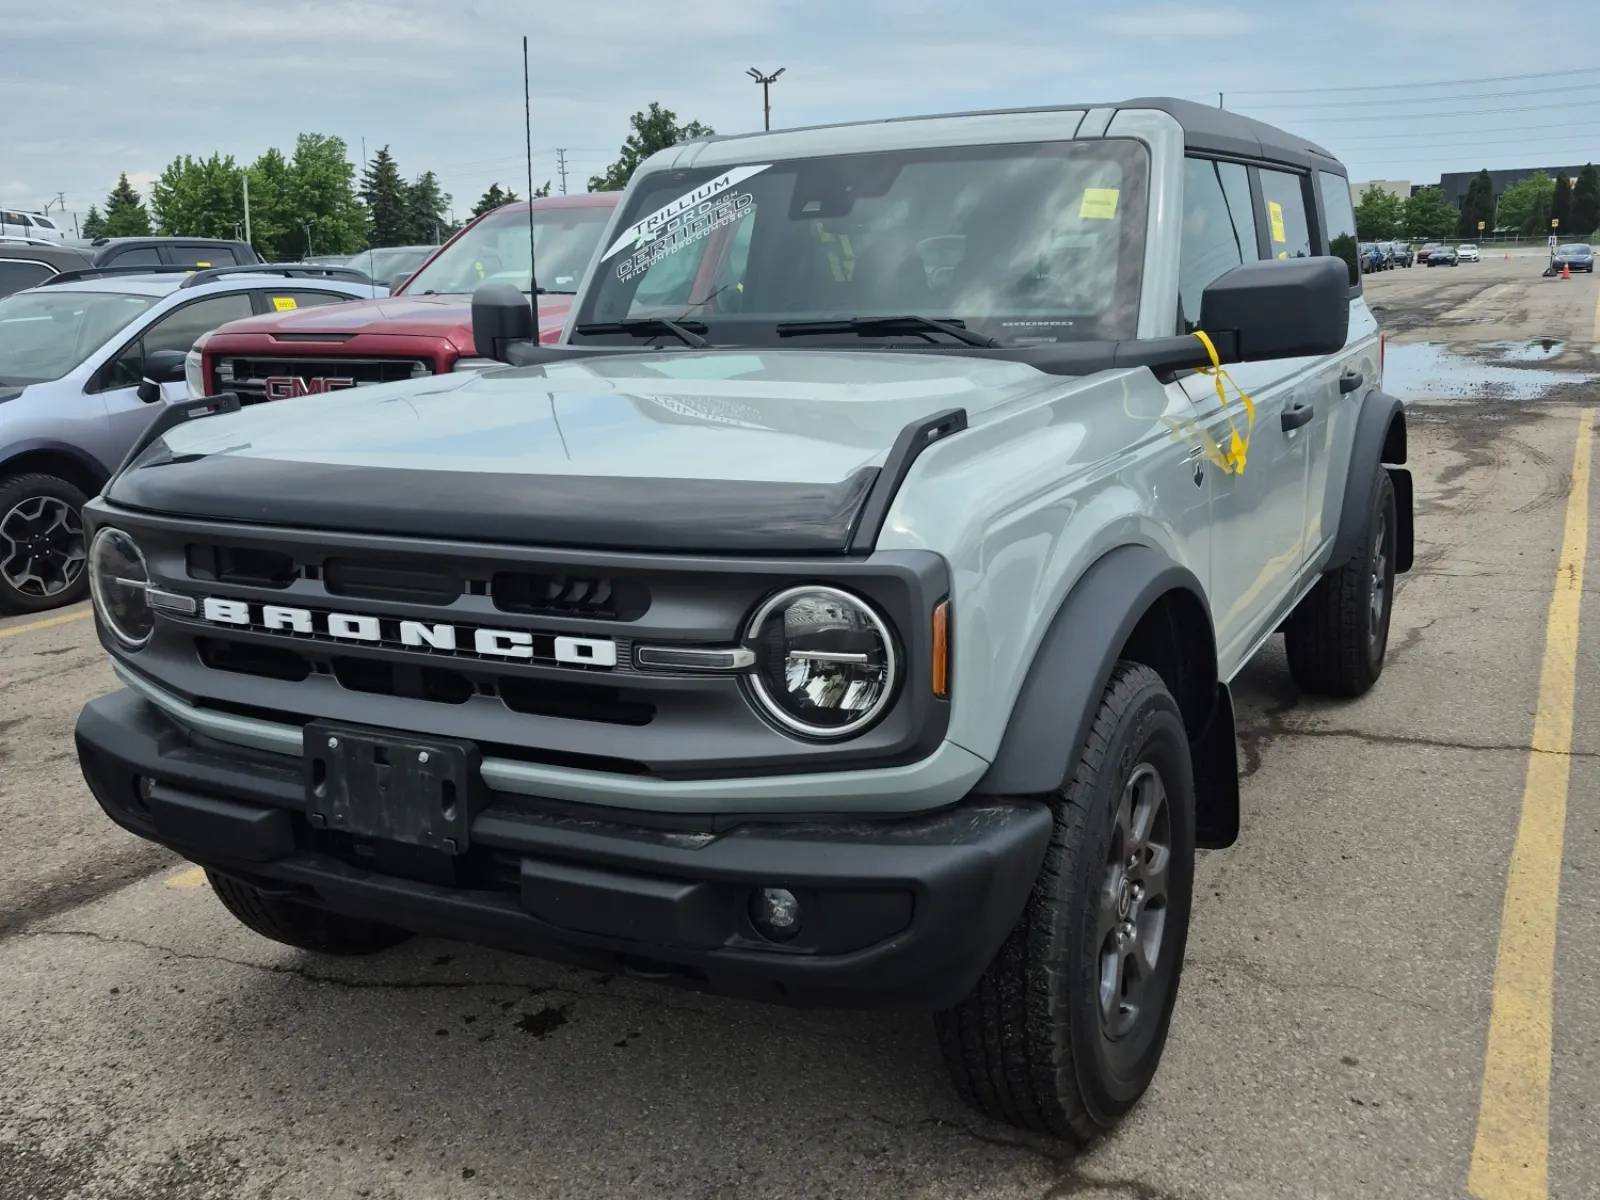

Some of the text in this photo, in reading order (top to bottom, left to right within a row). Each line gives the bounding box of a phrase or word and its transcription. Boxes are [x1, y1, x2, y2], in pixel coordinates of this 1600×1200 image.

[617, 193, 753, 279] CERTIFIED
[632, 177, 730, 234] TRILLIUM
[266, 375, 355, 401] GMC
[204, 597, 617, 667] BRONCO
